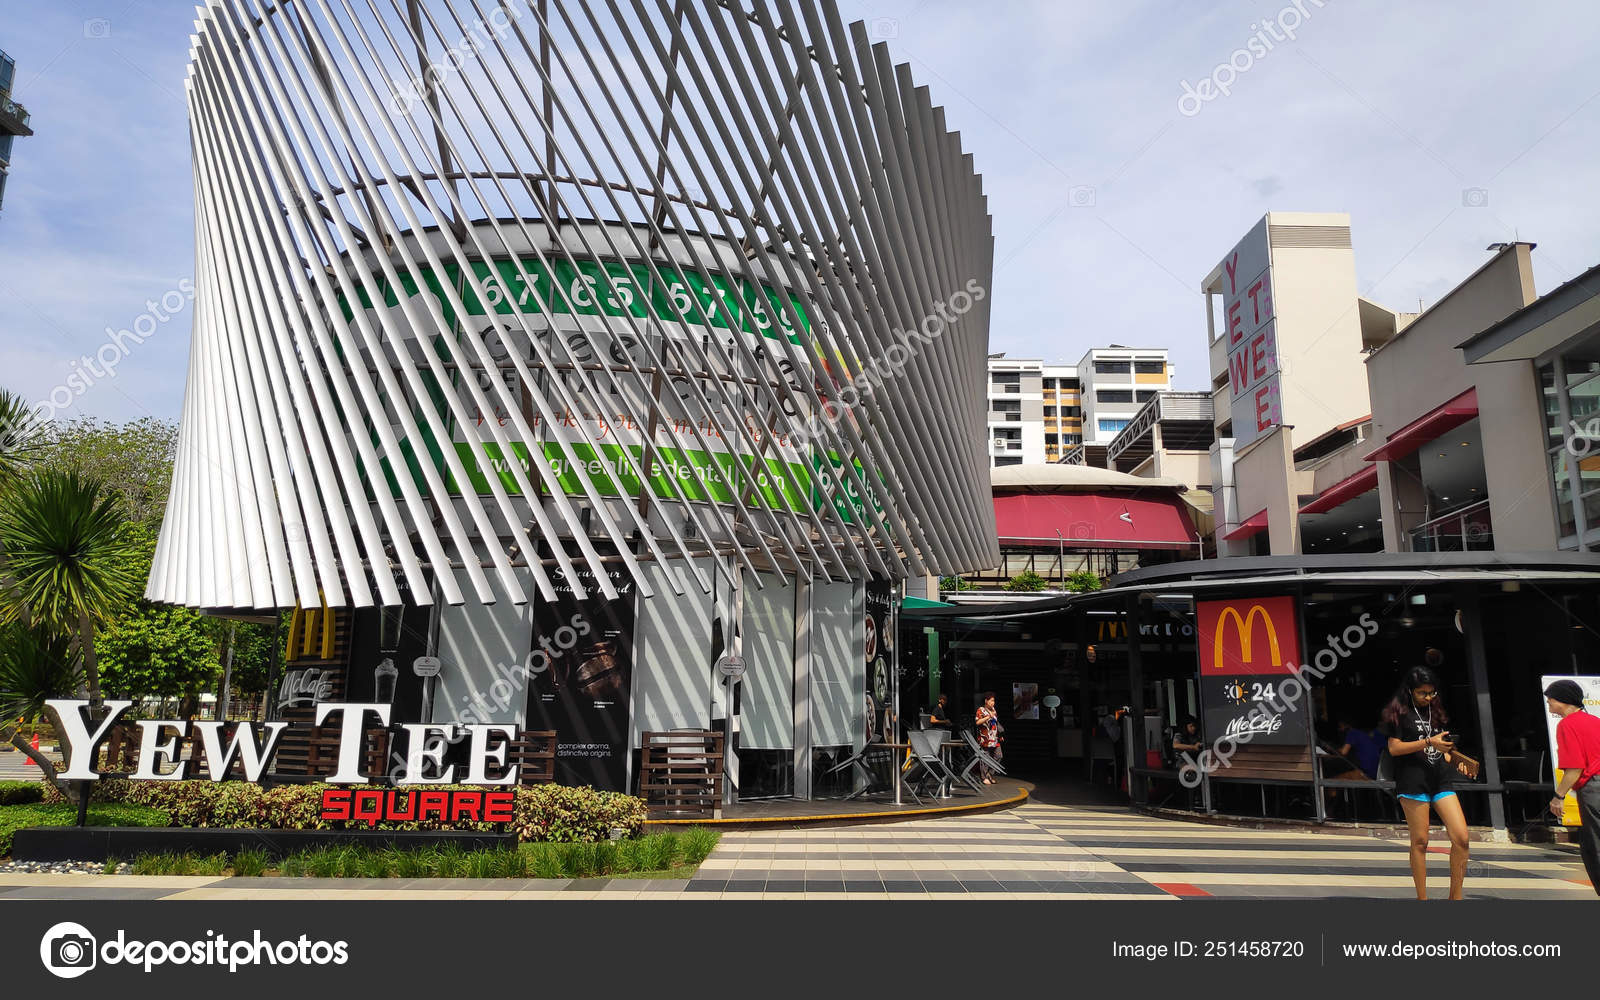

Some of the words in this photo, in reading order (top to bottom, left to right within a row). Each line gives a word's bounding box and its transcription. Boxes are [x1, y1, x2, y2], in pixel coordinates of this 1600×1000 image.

[1225, 251, 1249, 396] YEW
[1248, 280, 1272, 433] TEE
[1252, 682, 1277, 701] 24
[321, 789, 515, 826] SQUARE
